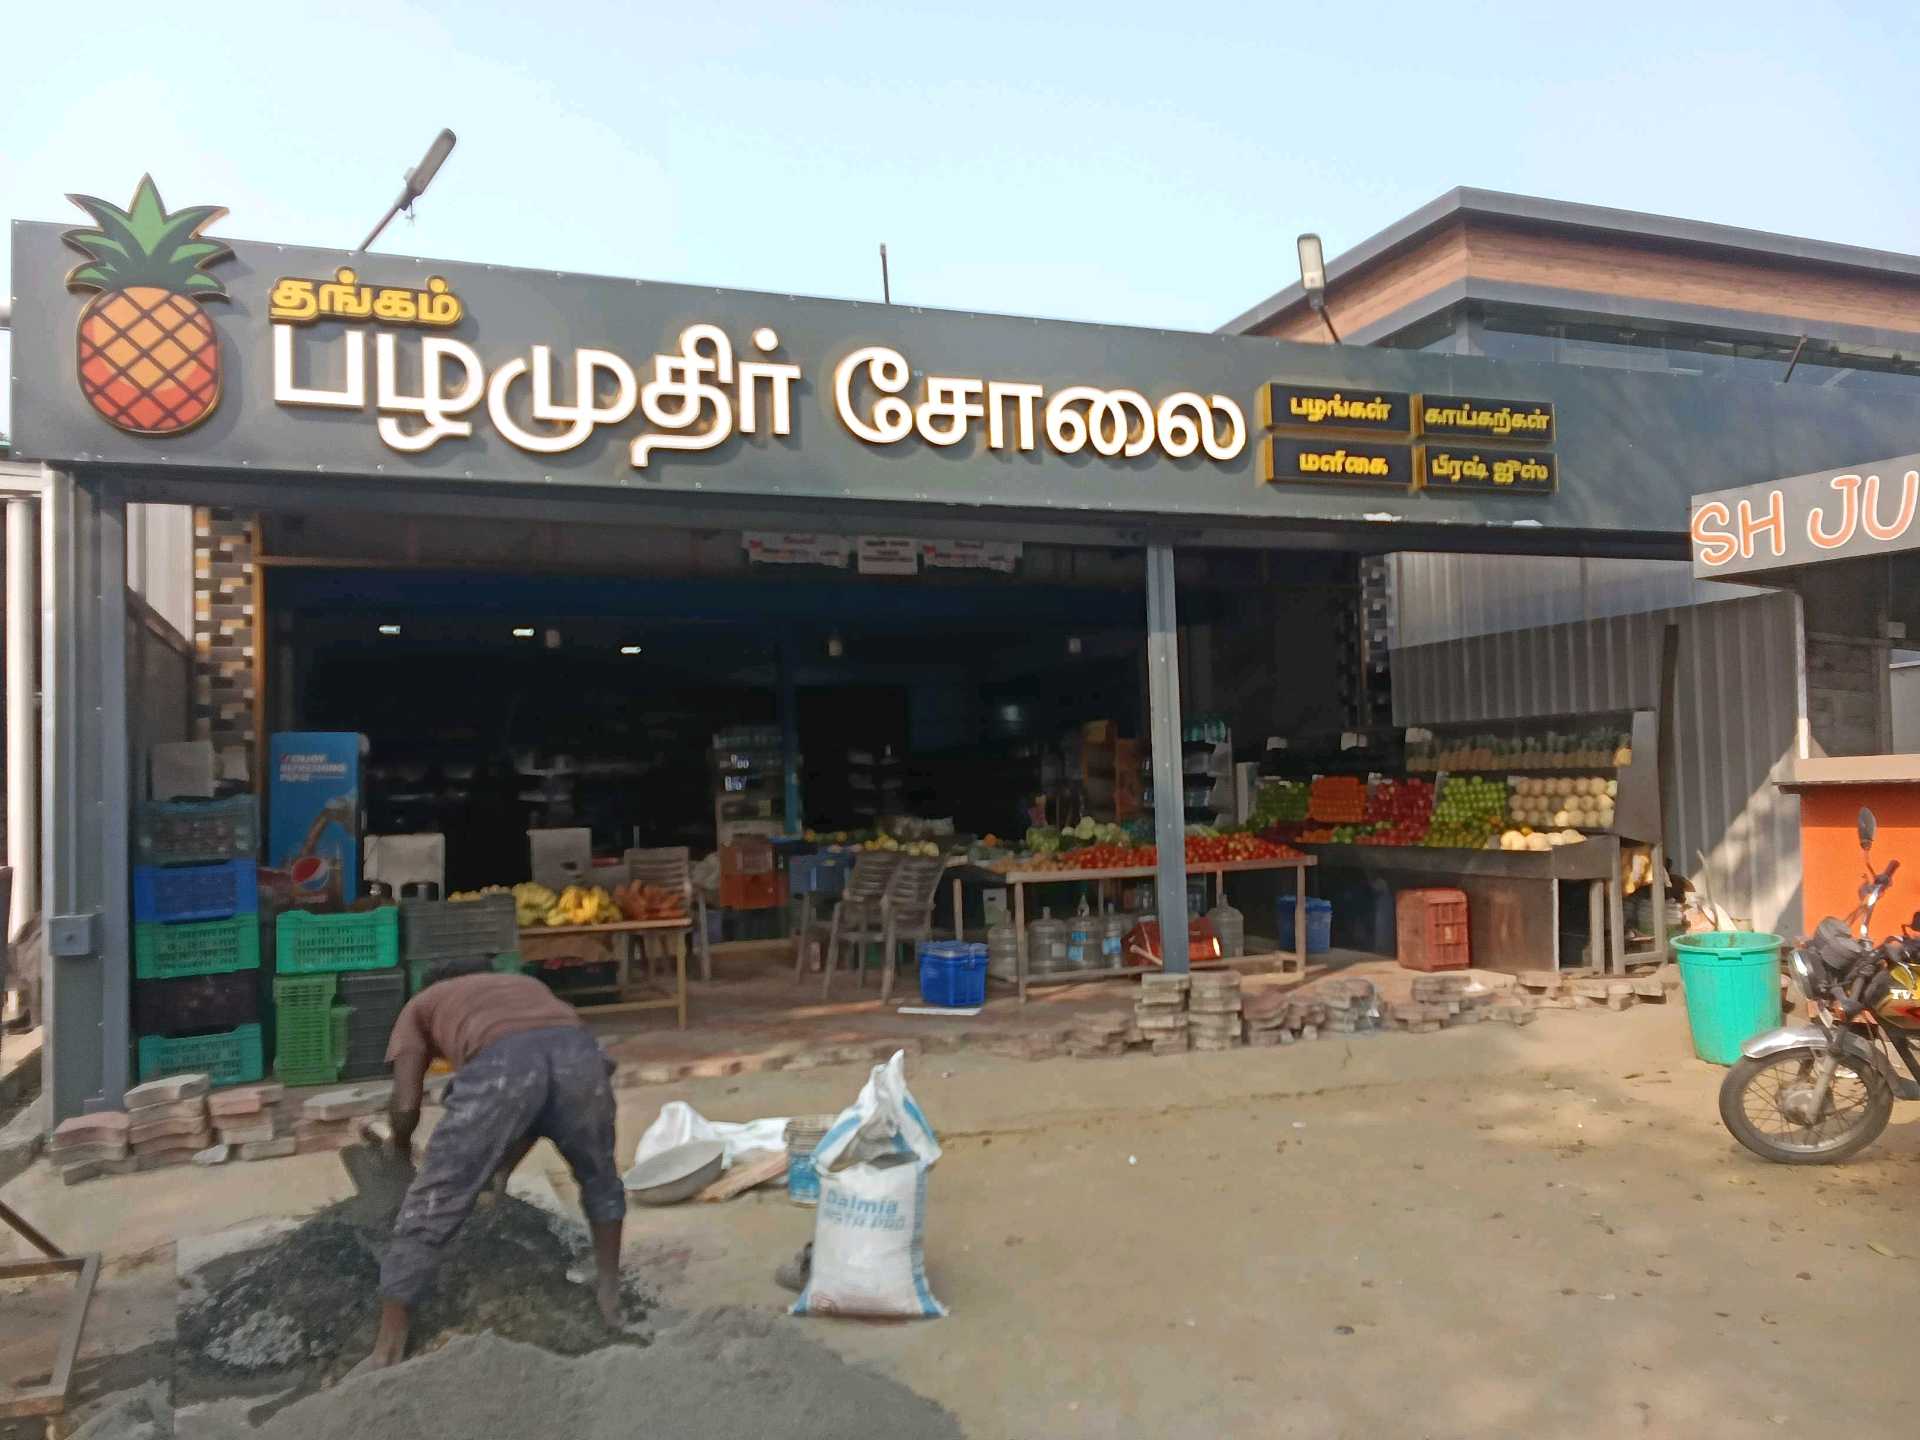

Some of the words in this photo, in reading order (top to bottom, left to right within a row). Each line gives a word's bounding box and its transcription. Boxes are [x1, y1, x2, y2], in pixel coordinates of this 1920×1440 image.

[270, 267, 462, 325] தங்கம்
[273, 323, 801, 468] பழமுதிர்
[834, 346, 1247, 460] சோலை
[1290, 393, 1392, 423] பழங்கள்
[1424, 404, 1550, 433] காய்கறிகள்
[1299, 450, 1388, 476] மளிகை
[1493, 458, 1549, 484] ஜூஸ்
[1691, 490, 1785, 566] SH
[1807, 470, 1919, 549] JU
